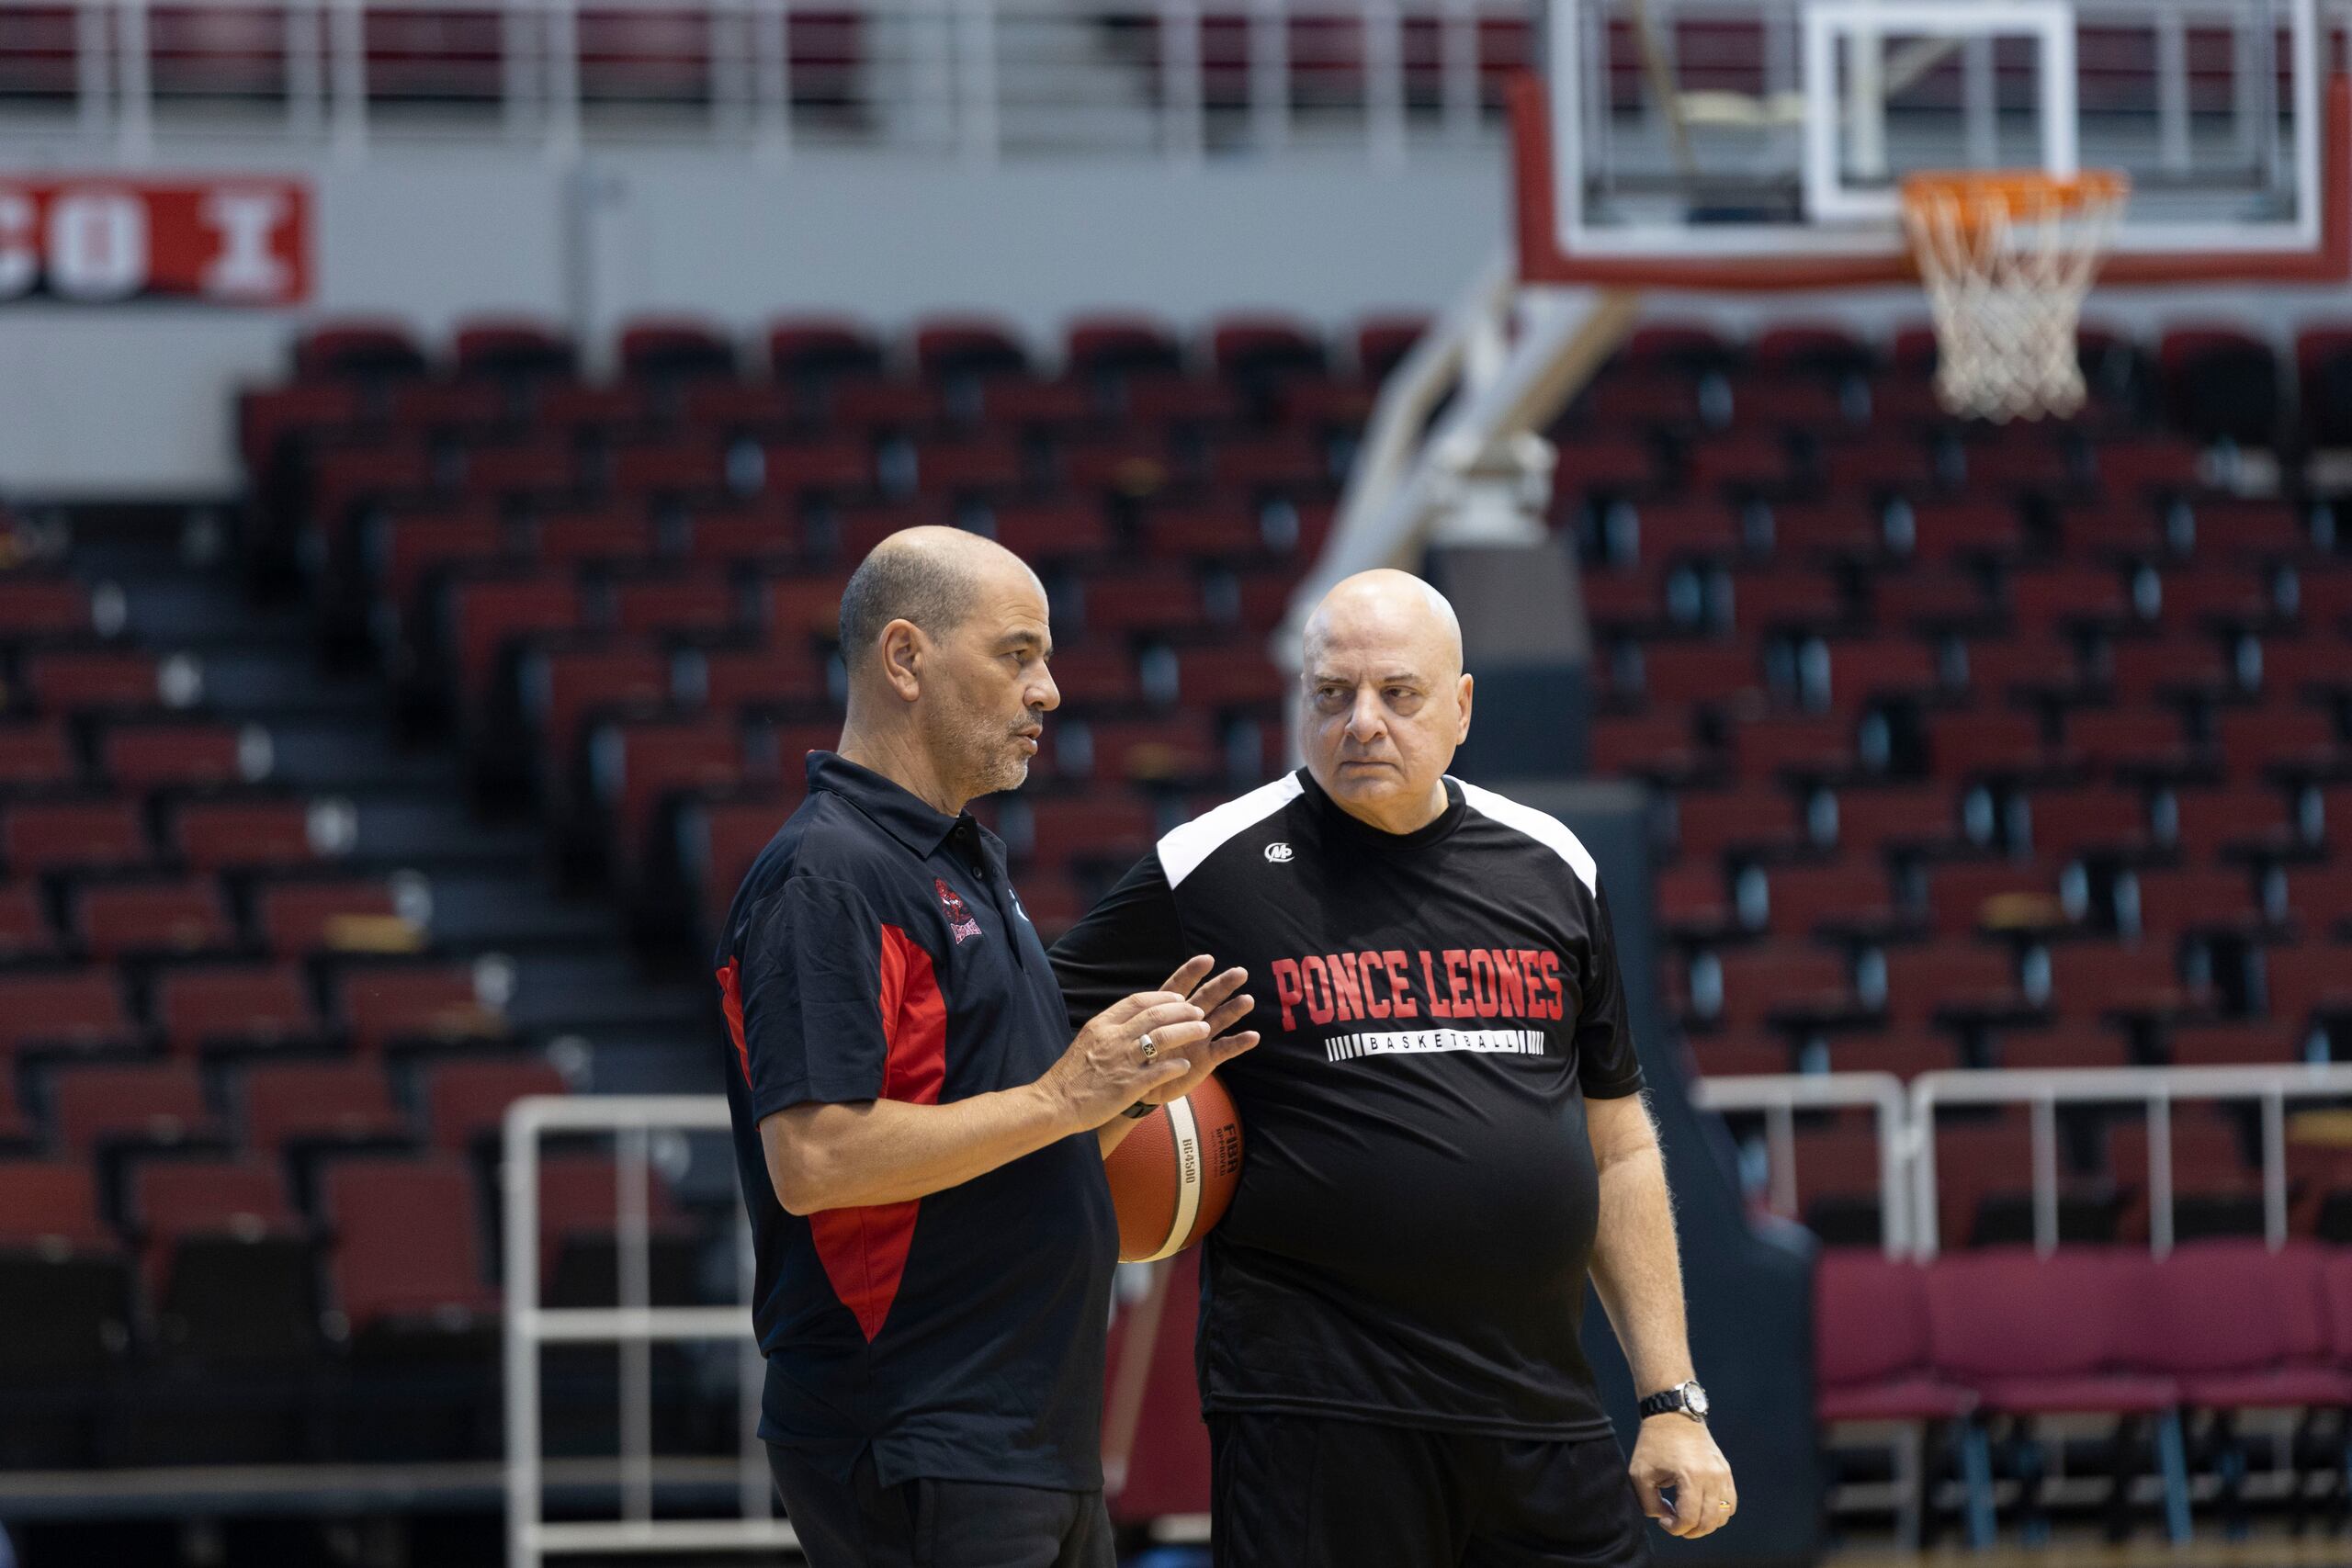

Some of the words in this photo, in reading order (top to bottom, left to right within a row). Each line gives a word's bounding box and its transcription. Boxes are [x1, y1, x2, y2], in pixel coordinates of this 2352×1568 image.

[1272, 950, 1418, 1032] PONCE
[1419, 949, 1563, 1021] LEONES
[1370, 1032, 1514, 1050] BASKETBALL
[1182, 1139, 1195, 1183] BG4500
[1216, 1128, 1227, 1177] APPROVED
